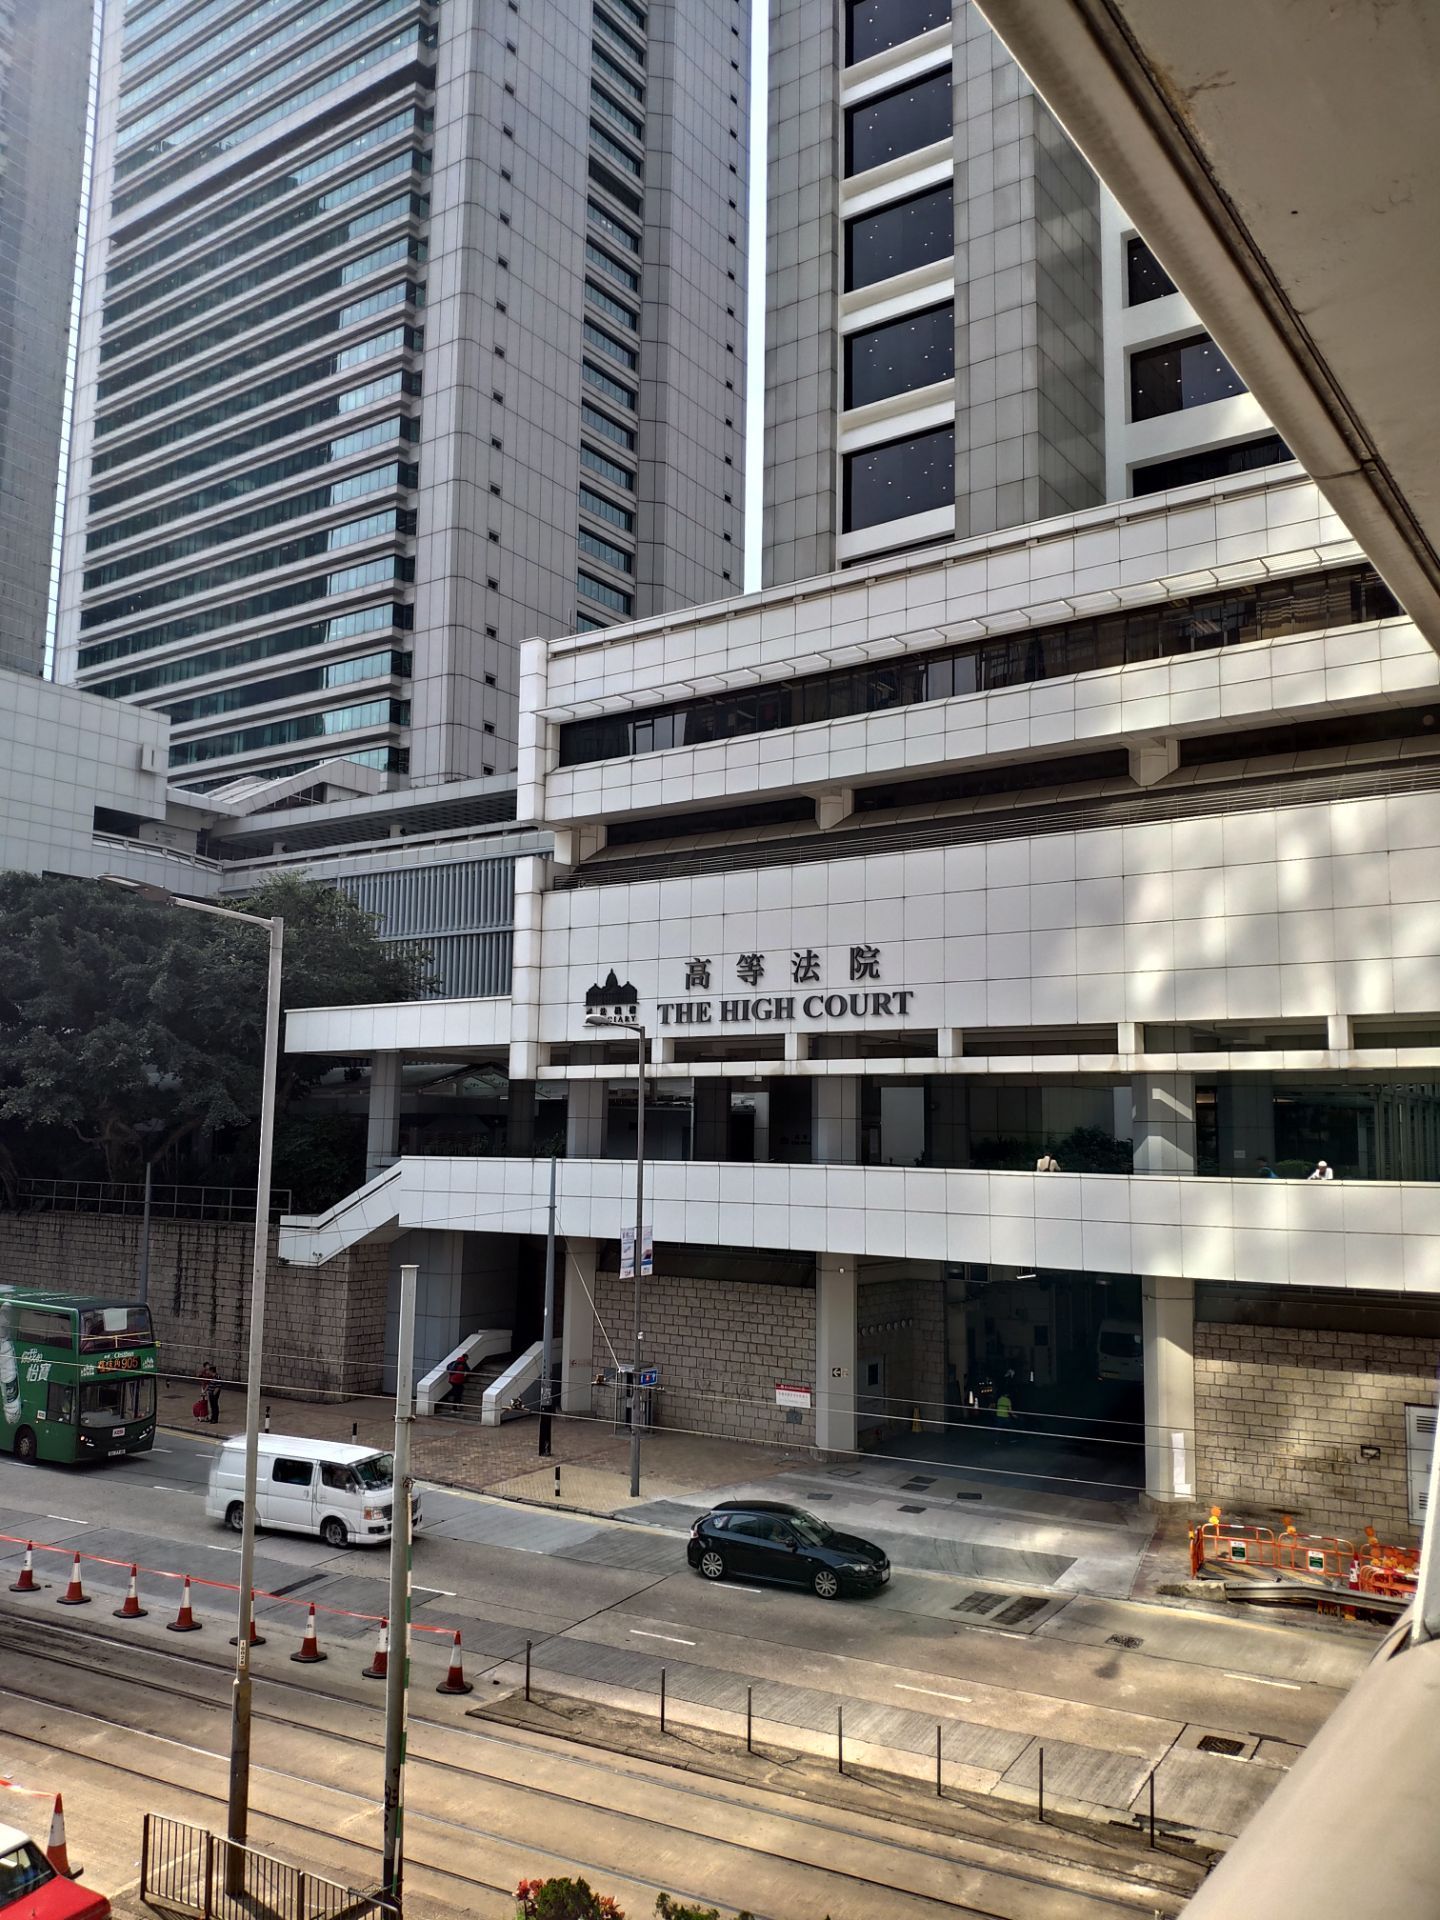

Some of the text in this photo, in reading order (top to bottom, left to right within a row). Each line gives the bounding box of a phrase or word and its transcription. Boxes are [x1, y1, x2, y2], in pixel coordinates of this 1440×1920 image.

[685, 945, 881, 990] 高等法院
[657, 991, 914, 1025] THE HIGH COURT
[121, 1357, 139, 1369] 905
